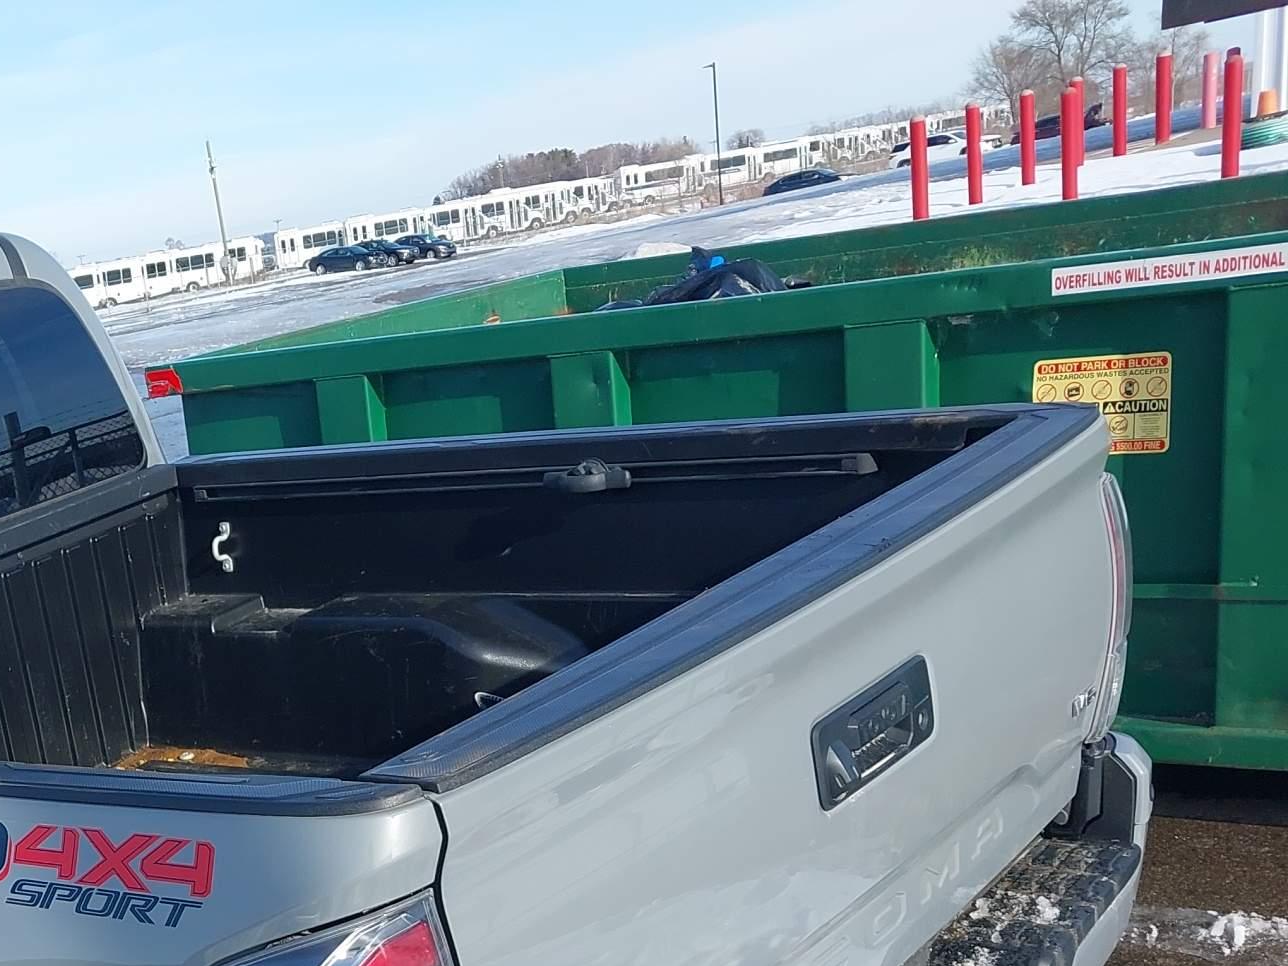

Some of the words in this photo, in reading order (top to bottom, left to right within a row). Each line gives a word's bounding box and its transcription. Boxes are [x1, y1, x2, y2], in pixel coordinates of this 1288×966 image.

[1054, 269, 1121, 290] OVERFILLING
[1124, 266, 1150, 282] WILL
[1153, 262, 1195, 279] RESULT
[1198, 259, 1210, 275] IN
[1213, 251, 1285, 273] ADDITIONAL
[1041, 364, 1056, 374] DO
[1058, 363, 1079, 373] NOT
[1081, 361, 1108, 371] PARK
[1111, 359, 1126, 369] OR
[1128, 357, 1164, 367] BLOCK
[1049, 373, 1095, 382] HAZARDOUS
[1096, 370, 1127, 378] WASTES
[1129, 368, 1169, 376] ACCEPTED
[1115, 400, 1167, 412] CAUTION
[1144, 441, 1161, 449] FINE
[5, 880, 203, 928] SPORT
